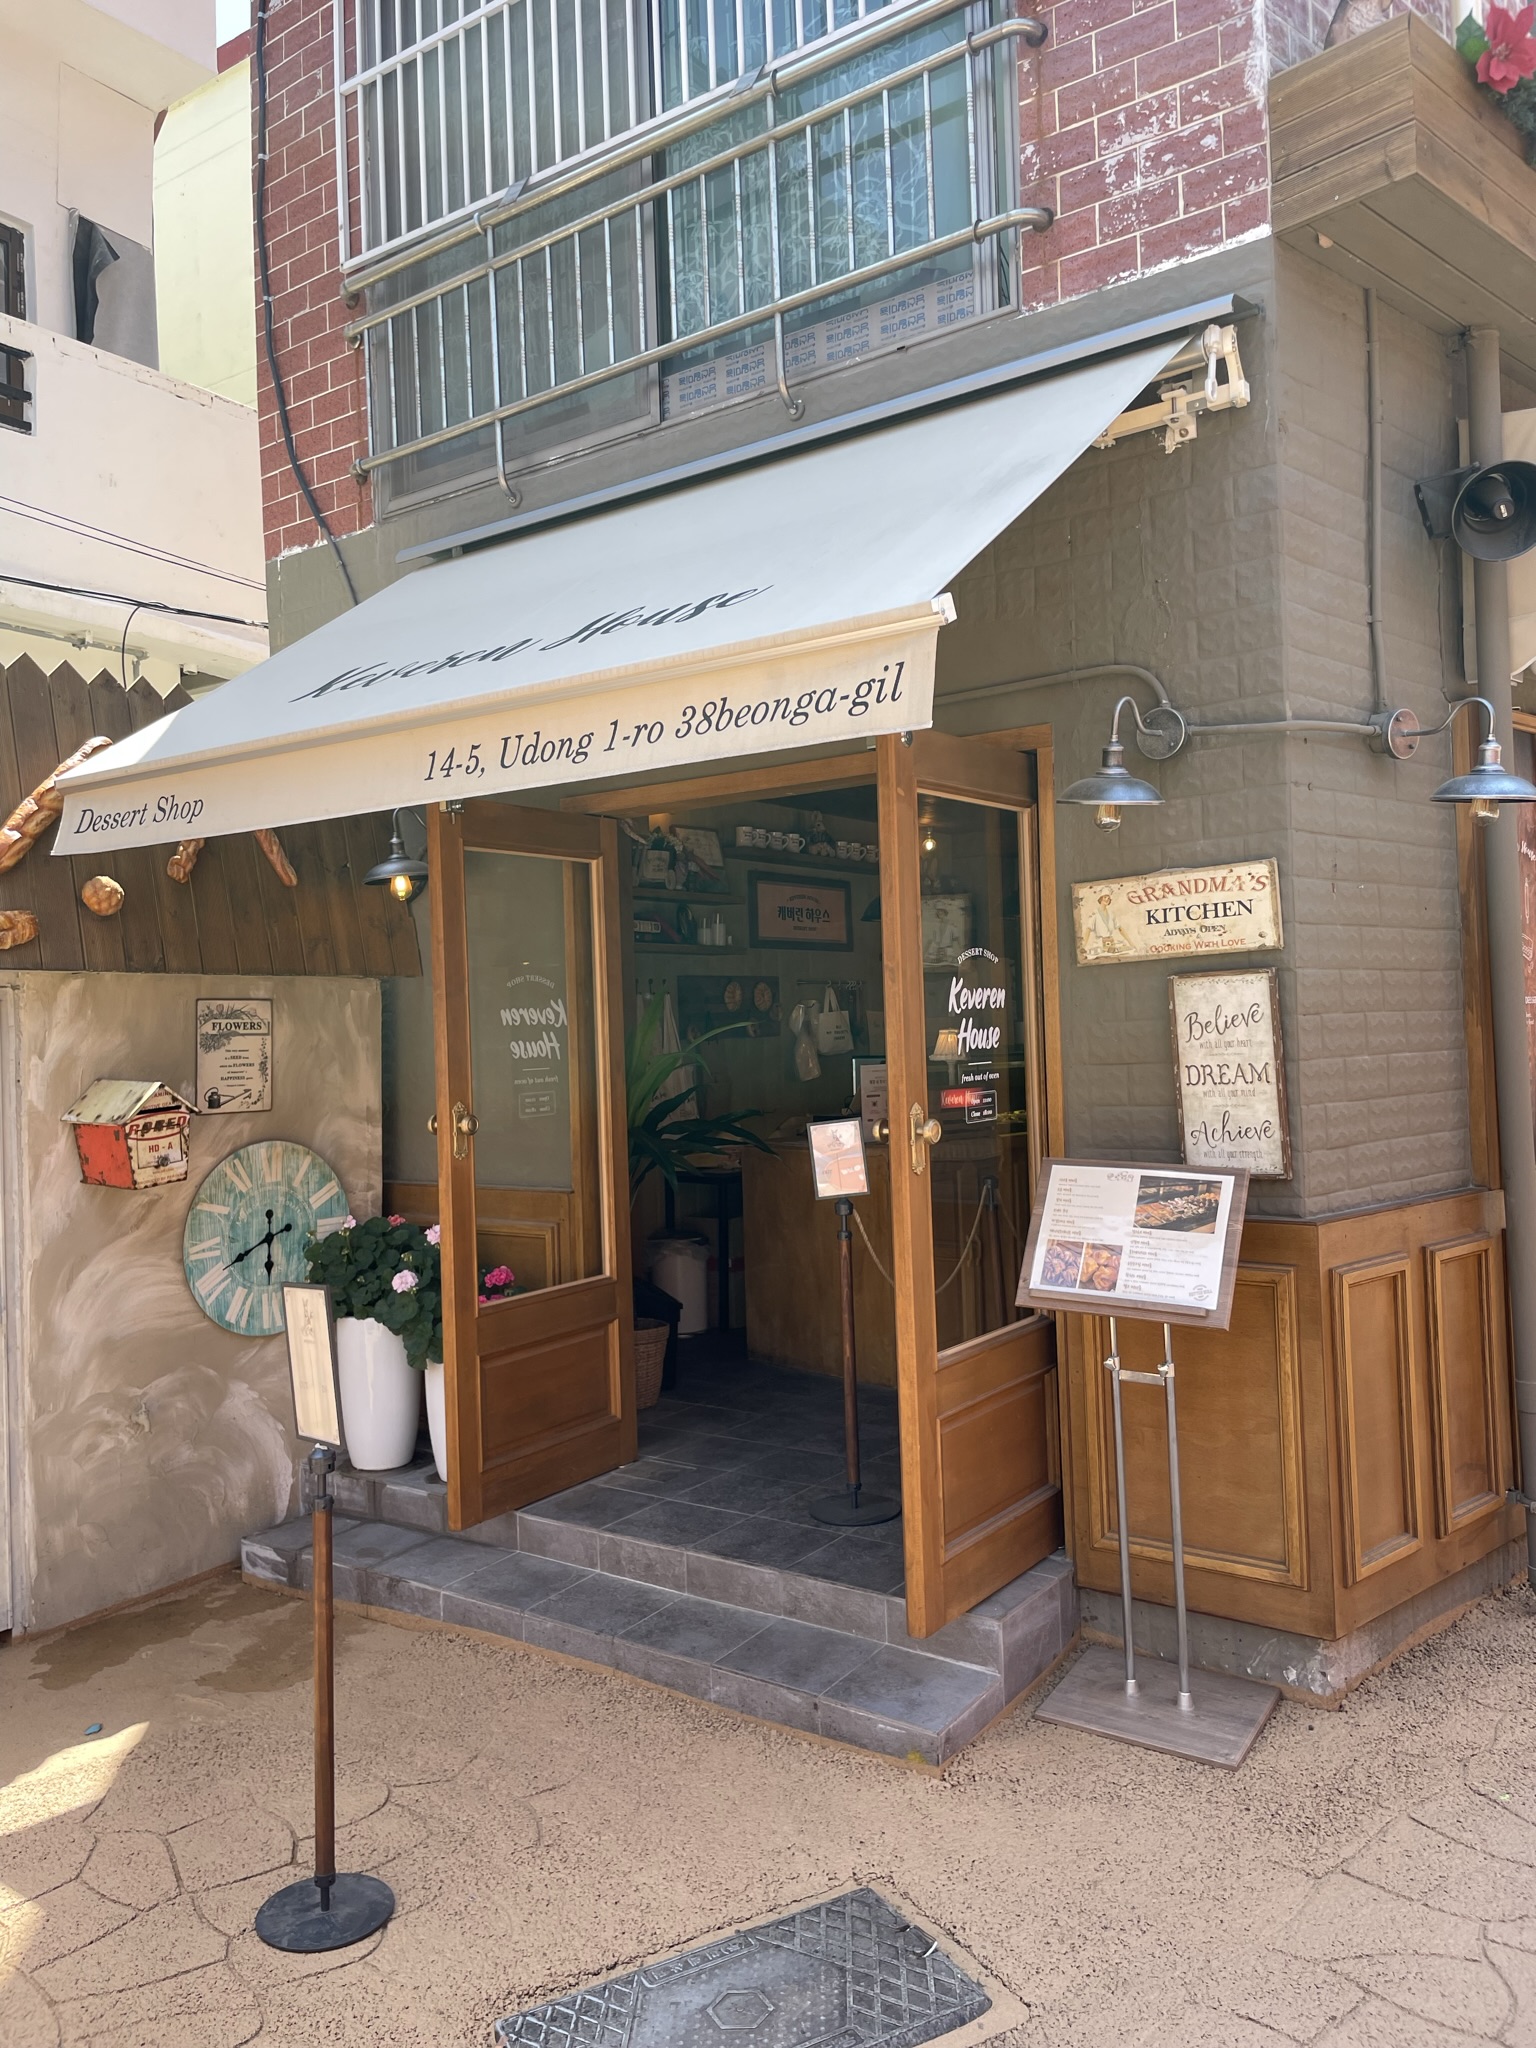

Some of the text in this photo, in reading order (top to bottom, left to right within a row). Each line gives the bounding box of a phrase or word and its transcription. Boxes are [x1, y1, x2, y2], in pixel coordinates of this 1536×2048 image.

[539, 584, 775, 651] House
[424, 661, 905, 781] 14-5, Udong 1-ro 38beonga-gil
[73, 795, 204, 835] Dessert Shop
[1126, 875, 1270, 905] GRANDMA'S
[805, 907, 831, 923] 하우스
[1145, 899, 1254, 926] KITCHEN
[957, 947, 999, 965] DESSERT SHOP
[1221, 938, 1246, 947] LOVE
[948, 976, 1006, 1014] Keveren
[212, 1022, 262, 1031] FLOWERS
[958, 1017, 1000, 1056] House
[1184, 1002, 1264, 1043] Believe
[1184, 1062, 1270, 1086] DREAM
[1190, 1110, 1275, 1148] Achieve
[148, 1144, 160, 1153] HD
[168, 1142, 173, 1150] A
